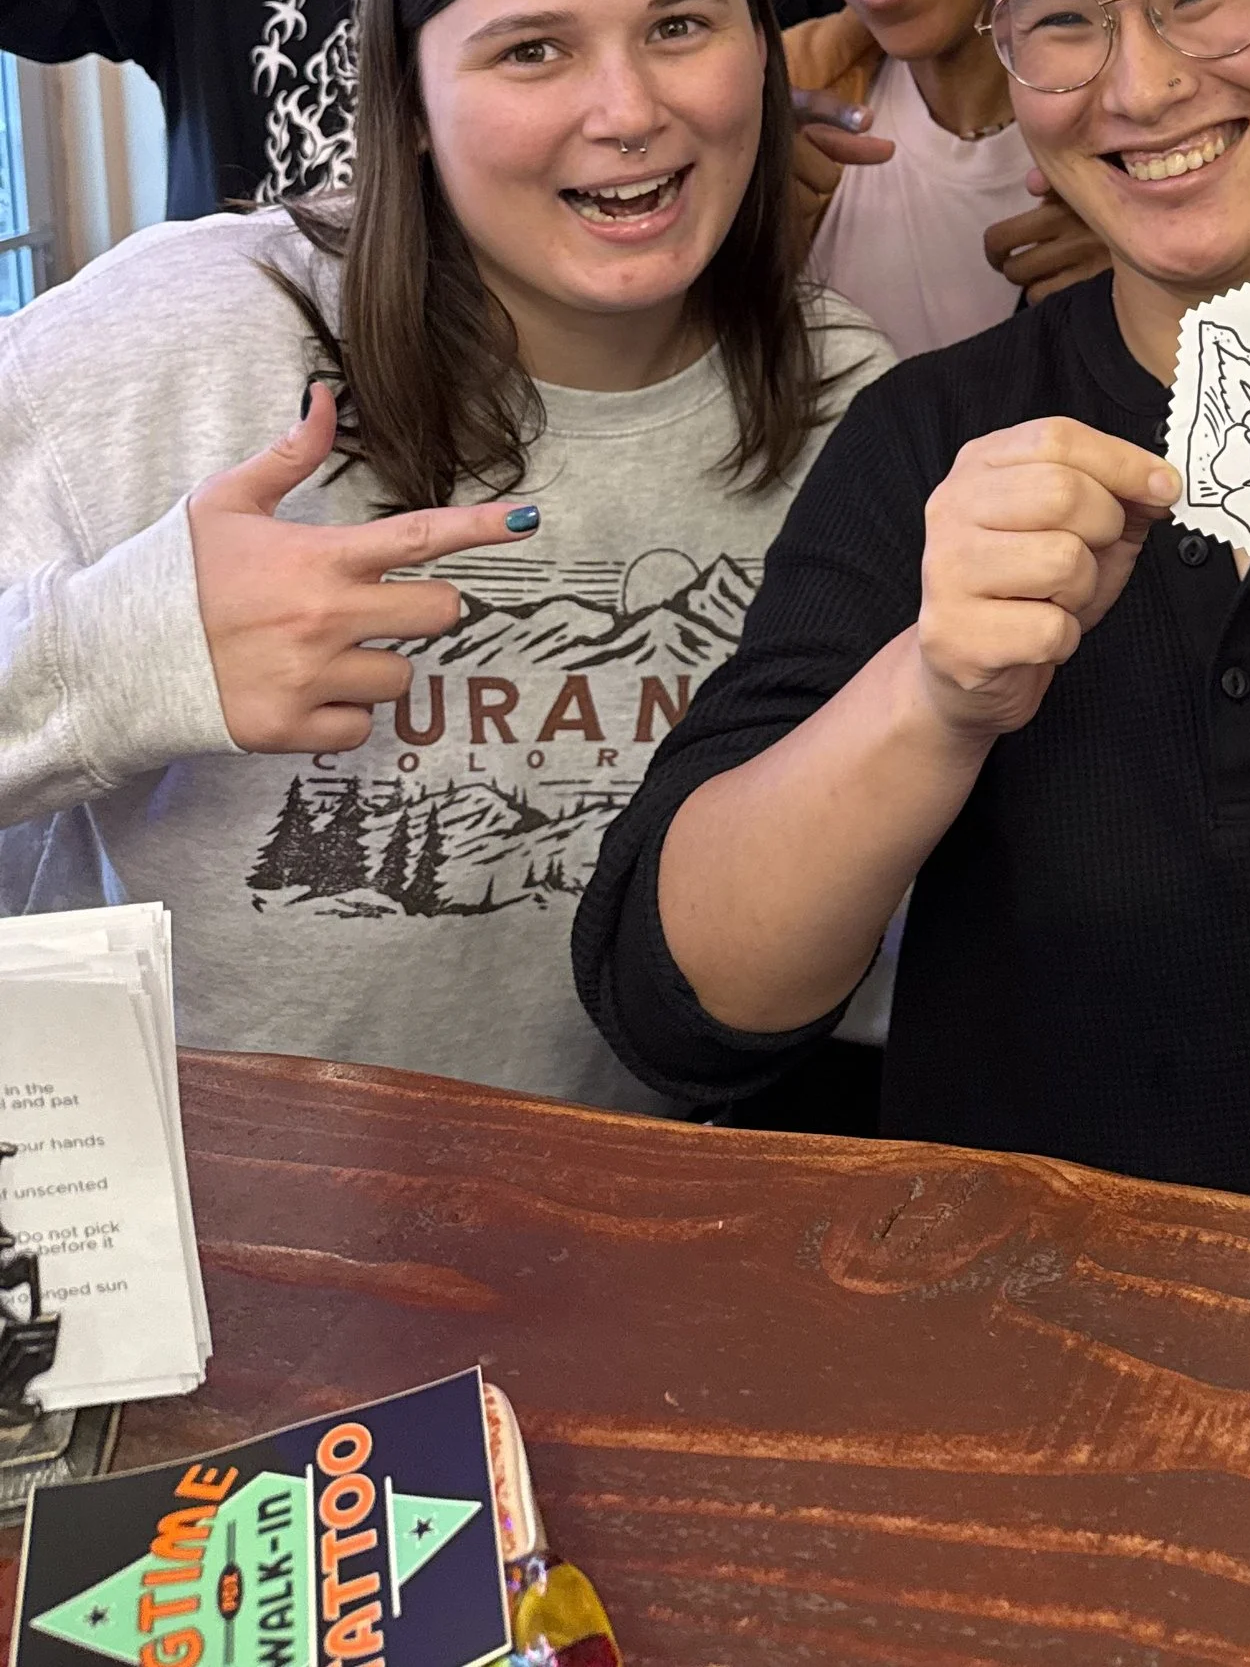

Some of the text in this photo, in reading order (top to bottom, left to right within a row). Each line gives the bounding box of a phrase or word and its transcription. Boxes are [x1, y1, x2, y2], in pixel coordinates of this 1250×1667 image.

[395, 674, 692, 746] URAN
[312, 748, 620, 773] COLOR
[4, 1083, 55, 1096] in the
[12, 1096, 45, 1109] and
[50, 1094, 80, 1109] pat
[17, 1134, 105, 1153] our hands
[14, 1177, 108, 1200] unscented
[18, 1220, 120, 1244] Do not pick
[38, 1239, 97, 1255] before
[102, 1236, 114, 1248] it
[96, 1281, 128, 1293] sun
